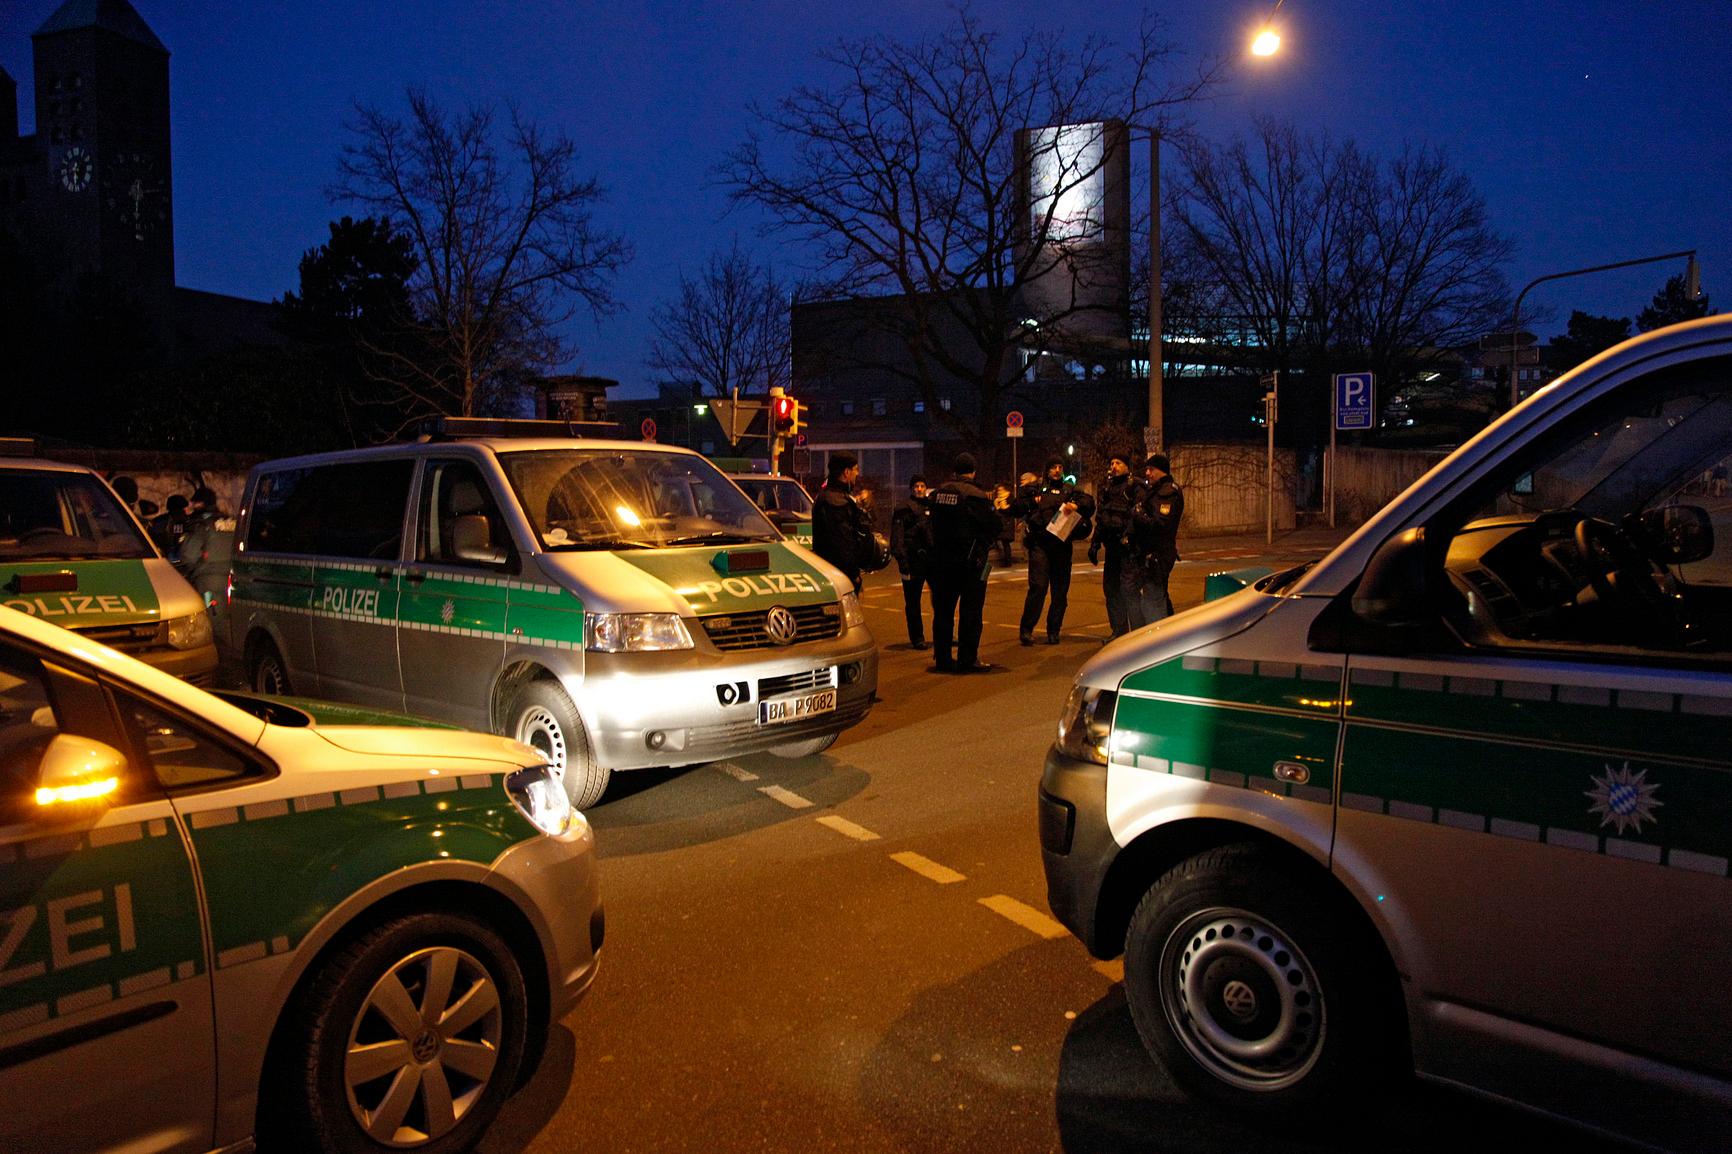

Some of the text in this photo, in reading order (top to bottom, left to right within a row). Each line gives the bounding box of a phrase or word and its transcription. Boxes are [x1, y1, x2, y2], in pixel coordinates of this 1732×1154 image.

[1345, 377, 1364, 406] P
[323, 586, 380, 617] POLIZEI
[699, 573, 822, 603] POLIZEI
[769, 701, 787, 720] BA
